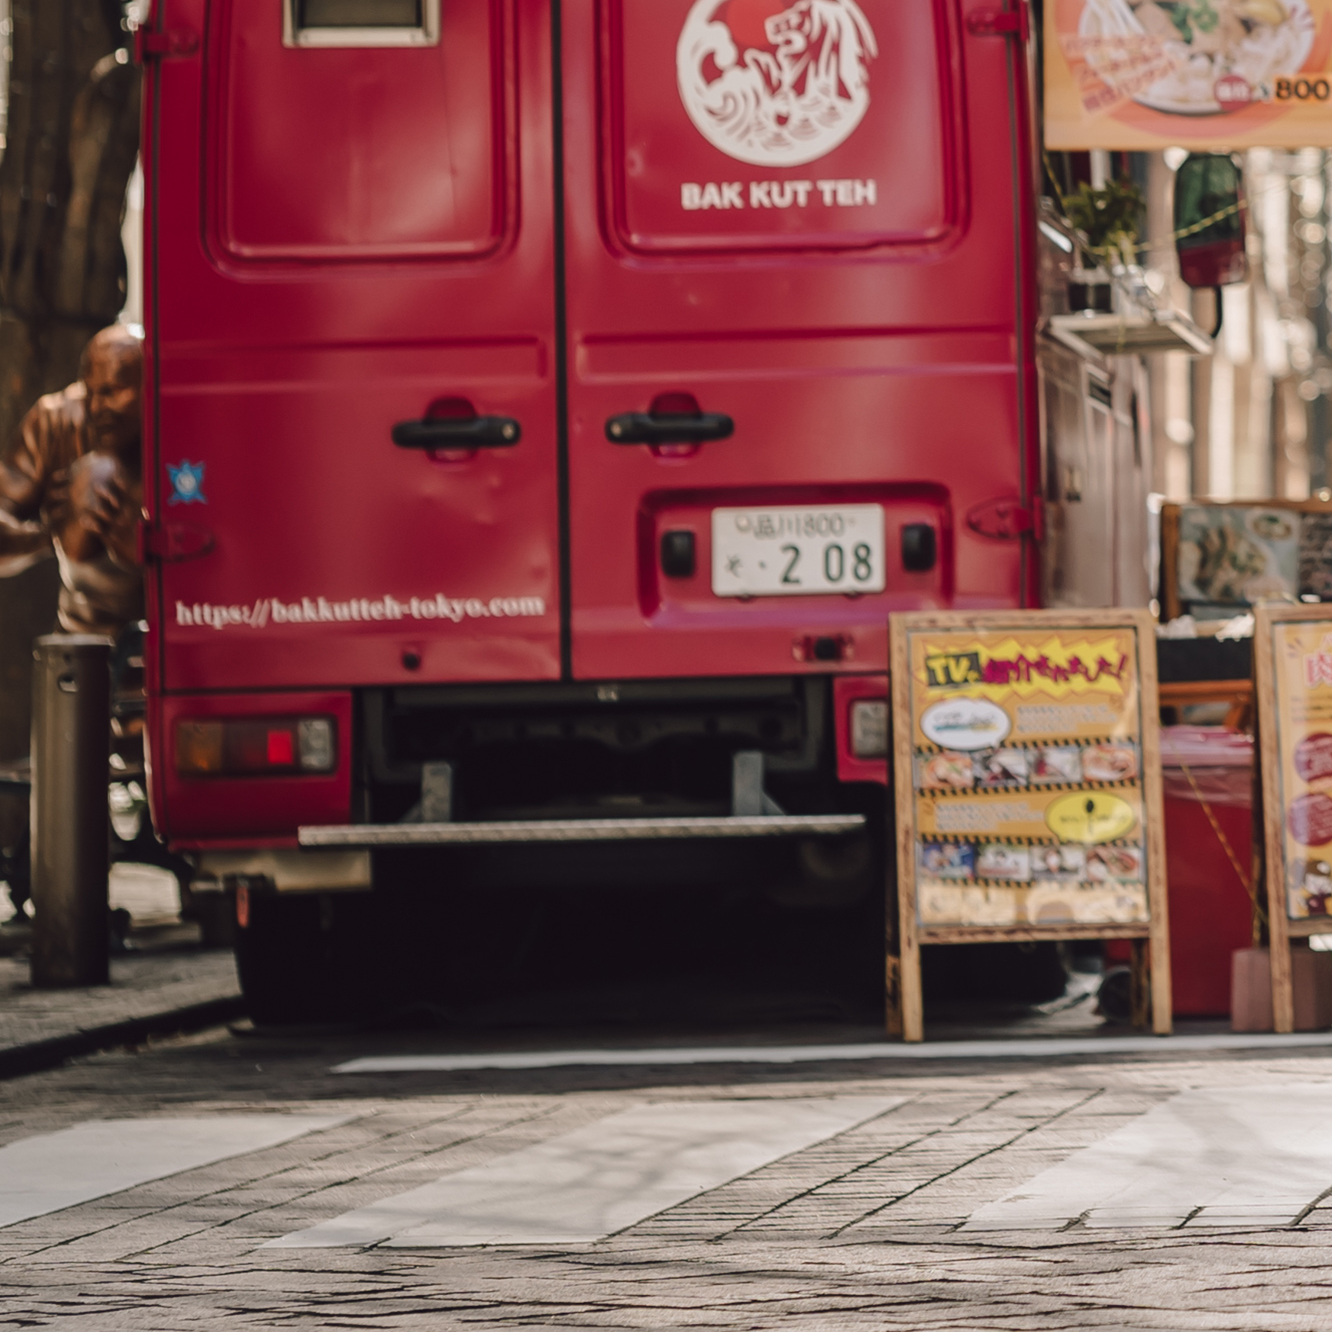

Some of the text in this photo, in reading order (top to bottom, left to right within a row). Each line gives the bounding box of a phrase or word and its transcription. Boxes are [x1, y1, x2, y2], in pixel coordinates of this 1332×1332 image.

[1275, 77, 1331, 101] 800
[680, 177, 878, 211] BAK KUT TEH
[174, 593, 546, 630] https://bakkutteh-tokyo.com
